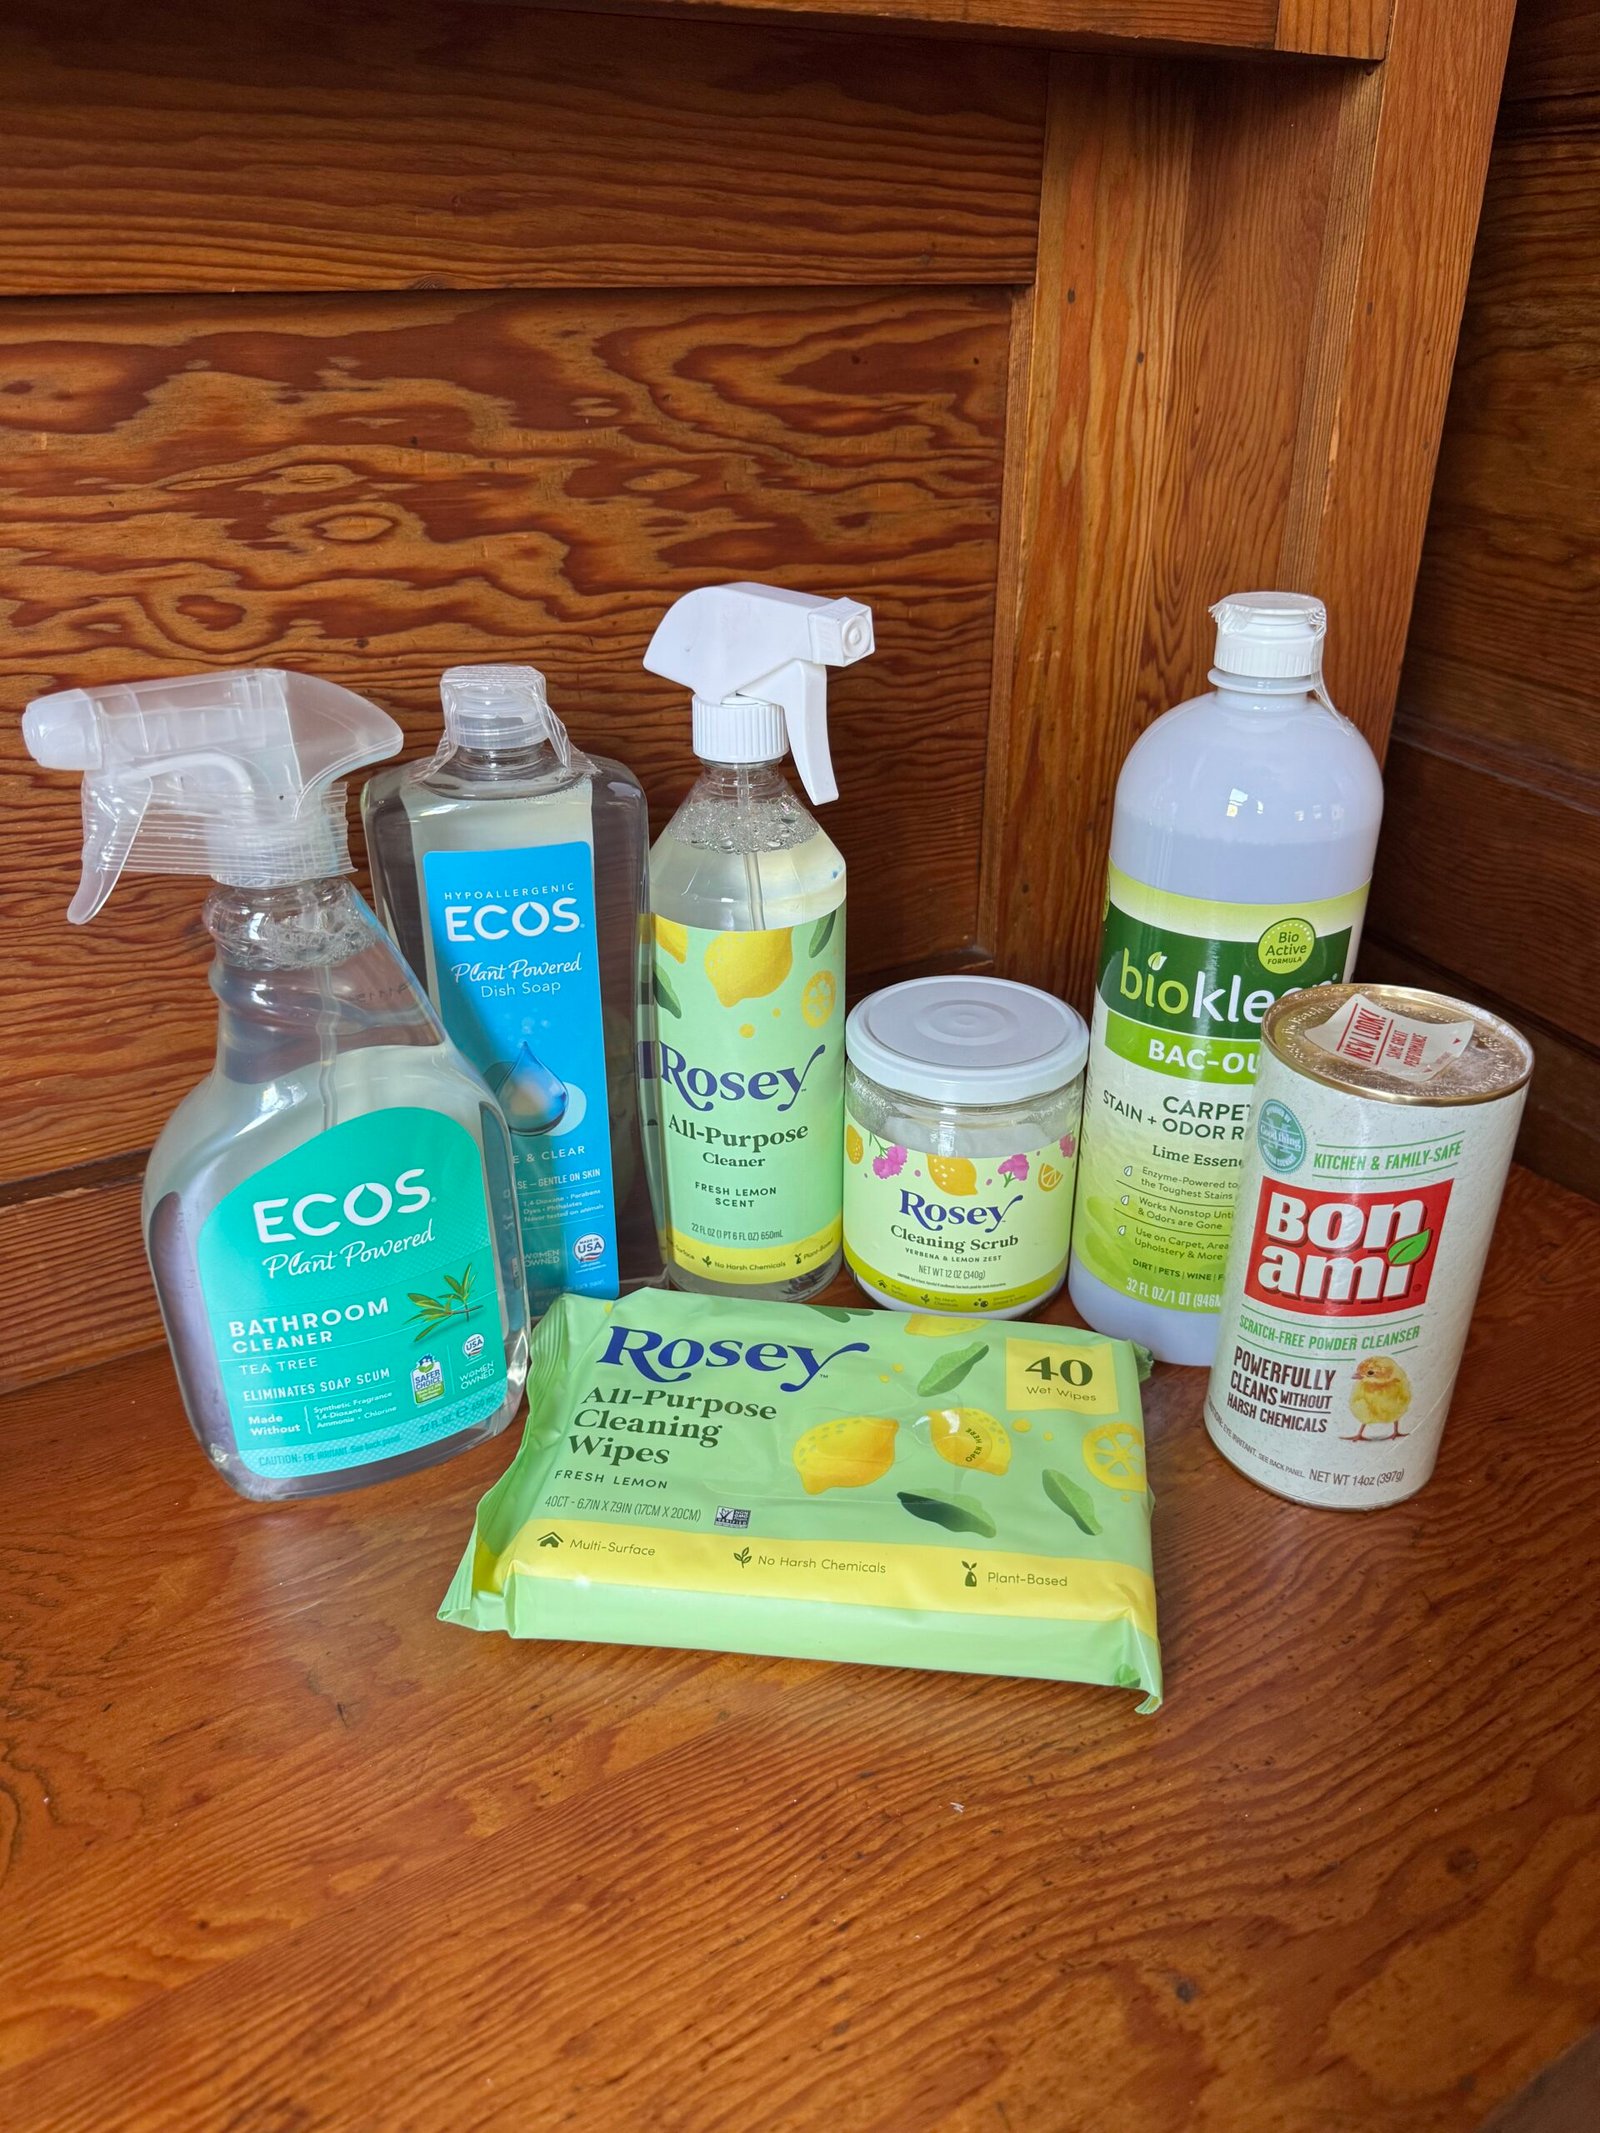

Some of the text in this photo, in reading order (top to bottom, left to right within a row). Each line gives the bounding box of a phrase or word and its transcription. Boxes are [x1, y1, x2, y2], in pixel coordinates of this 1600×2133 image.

[445, 882, 574, 900] HYPOALLERGENIC
[445, 897, 580, 942] ECOS
[1279, 931, 1299, 943] Bio
[1265, 944, 1307, 956] Active
[1267, 956, 1302, 965] FORMULA
[451, 952, 582, 983] Plant Powered
[481, 981, 560, 998] Dish Soap
[1120, 947, 1332, 1023] biokle
[1342, 1007, 1387, 1062] NEW LOOK!
[1385, 1029, 1409, 1059] SAME GREAT
[1148, 1038, 1260, 1074] BAC-OU
[1403, 1032, 1428, 1068] PERFORMANCE
[659, 1040, 826, 1112] Rosey
[1103, 1089, 1142, 1123] STAIN
[1162, 1118, 1226, 1140] ODOR
[668, 1114, 809, 1153] All-Purpose
[526, 1153, 535, 1163] &
[541, 1145, 585, 1160] CLEAR
[703, 1152, 766, 1167] Cleaner
[1152, 1144, 1190, 1163] Lime
[1313, 1153, 1366, 1170] KITCHEN
[1370, 1155, 1380, 1170] &
[1385, 1140, 1463, 1170] FAMILY-SAFE
[538, 1174, 567, 1187] GENTLE
[570, 1171, 580, 1181] ON
[583, 1168, 600, 1179] SKIN
[694, 1181, 777, 1197] FRESH LEMON
[1141, 1178, 1233, 1200] the Toughest Stains
[1142, 1166, 1238, 1189] Enzyme-Powered to
[570, 1189, 600, 1199] Parabens
[715, 1197, 755, 1208] SCENT
[253, 1169, 431, 1243] ECOS
[899, 1188, 1024, 1233] Rosey
[1139, 1196, 1211, 1220] Works Nonstop
[1137, 1207, 1222, 1230] & Odors are Gone
[1265, 1191, 1424, 1250] Bon
[691, 1222, 699, 1233] 22
[699, 1225, 707, 1235] FL
[707, 1227, 716, 1238] OZ
[723, 1229, 731, 1239] PT
[732, 1230, 737, 1240] 6
[739, 1230, 748, 1240] FL
[749, 1230, 759, 1242] OZ)
[890, 1224, 1019, 1253] Cleaning Scrub
[1135, 1227, 1229, 1250] Use on Carpet, Area
[262, 1219, 435, 1279] Plant Powered
[578, 1241, 602, 1254] USA
[905, 1247, 939, 1260] VERBENA
[951, 1255, 980, 1263] LEMON
[1134, 1237, 1223, 1260] Upholstery & More
[726, 1261, 786, 1271] Harsh Chemicals
[918, 1265, 985, 1280] NET WT 12 OZ (340g)
[1132, 1258, 1153, 1271] DIRT
[1158, 1267, 1180, 1278] PETS
[1187, 1272, 1211, 1281] WINE
[1257, 1245, 1412, 1301] ami
[1126, 1277, 1138, 1293] 32
[1140, 1282, 1148, 1297] FL
[1152, 1286, 1175, 1303] OZ/1
[229, 1297, 389, 1337] BATHROOM
[232, 1330, 333, 1354] CLEANER
[1239, 1314, 1421, 1351] SCRATCH-FREE POWDER CLEANSER
[466, 1338, 483, 1351] USA
[238, 1356, 318, 1376] TEA TREE
[596, 1325, 870, 1392] Rosey
[1234, 1345, 1337, 1391] POWERFULLY
[415, 1369, 441, 1383] SAFER
[460, 1361, 494, 1381] WOMEN
[461, 1369, 494, 1389] OWNED
[1025, 1356, 1093, 1387] 40
[242, 1368, 390, 1401] ELIMINATES SOAP SCUM
[415, 1377, 441, 1391] CHOICE
[1026, 1386, 1097, 1402] Wet Wipes
[1230, 1370, 1333, 1410] CLEANS WITHOUT
[313, 1391, 392, 1414] Synthetic Fragrance
[580, 1386, 777, 1420] All-Purpose
[1227, 1392, 1257, 1420] HARSH
[1259, 1408, 1328, 1433] CHEMICALS
[248, 1413, 283, 1425] Made
[316, 1406, 397, 1429] Ammonia Chlorine
[573, 1408, 724, 1449] Cleaning
[250, 1423, 301, 1436] Without
[568, 1434, 670, 1467] Wipes
[965, 1428, 983, 1463] OPEN HERE
[554, 1469, 668, 1489] FRESH LEMON
[1309, 1468, 1405, 1487] NET WT 14oz (397g)
[545, 1495, 570, 1508] 40CT
[601, 1500, 608, 1511] X
[609, 1501, 633, 1514] 7.9IN
[634, 1503, 662, 1517] (17CM
[662, 1505, 670, 1518] X
[670, 1507, 702, 1522] 20CM)
[569, 1538, 656, 1556] Multi-Surface
[758, 1555, 886, 1575] No Harsh Chemicals
[988, 1572, 1068, 1588] Plant-Based
